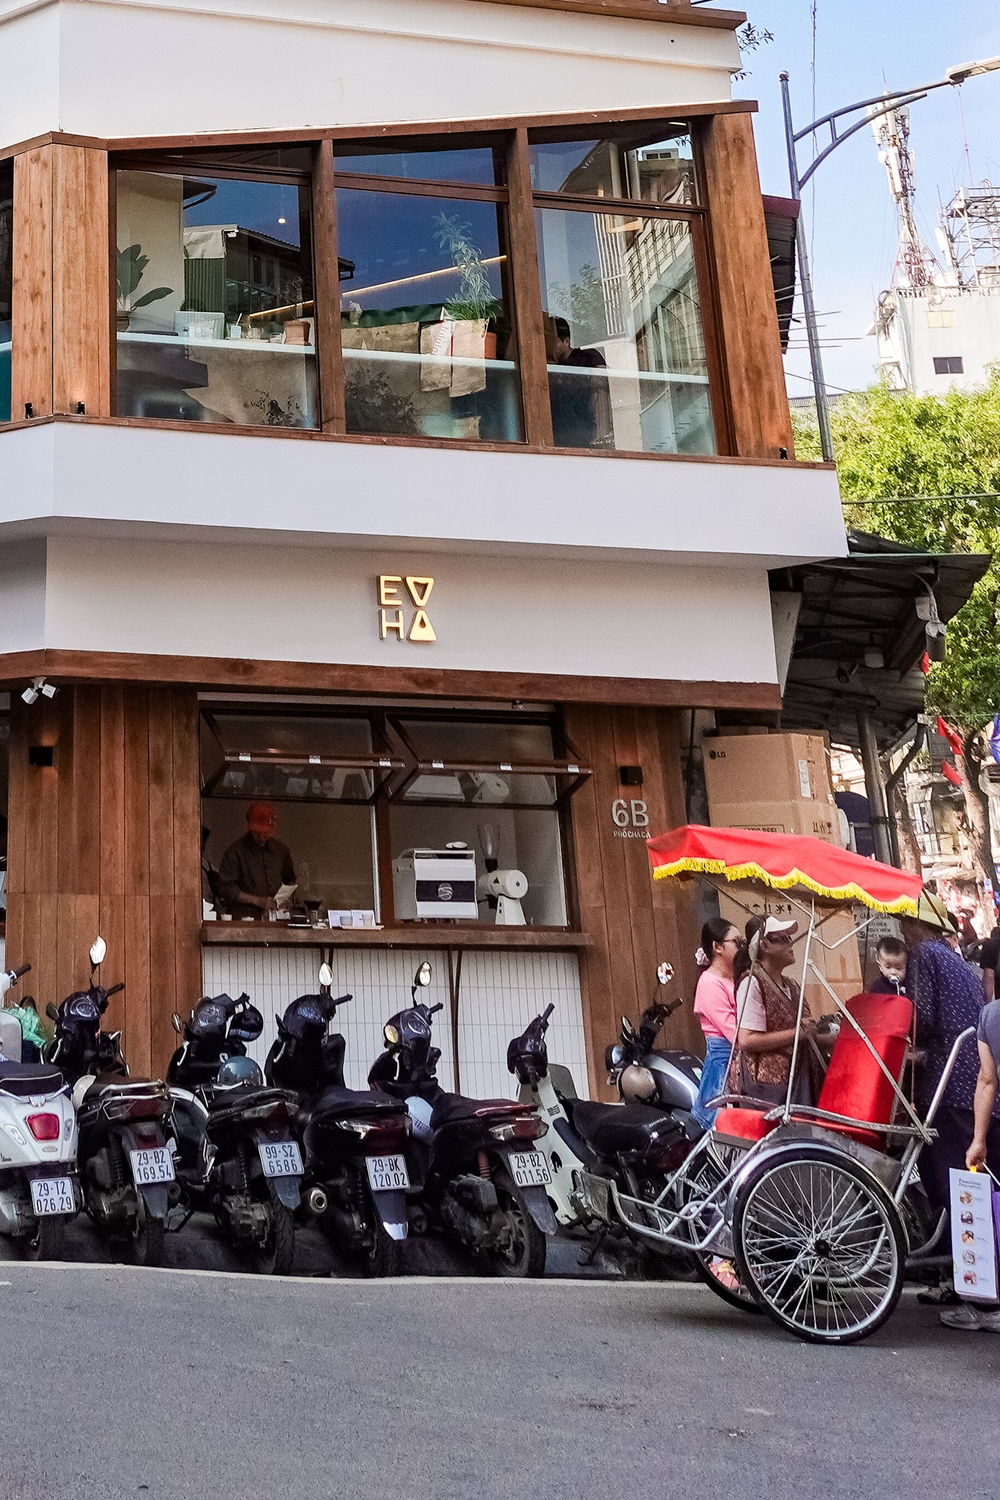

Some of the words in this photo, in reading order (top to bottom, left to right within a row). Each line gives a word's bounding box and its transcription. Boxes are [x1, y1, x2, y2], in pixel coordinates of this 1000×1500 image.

[612, 798, 650, 827] 6B
[137, 1150, 166, 1166] 29-B2
[515, 1153, 542, 1169] 29-B2
[137, 1164, 172, 1181] 169.54
[268, 1159, 298, 1174] 6586
[373, 1172, 407, 1188] 120.02
[516, 1168, 549, 1184] 011.56
[37, 1180, 67, 1197] 29-T2
[36, 1196, 72, 1213] 026.29
